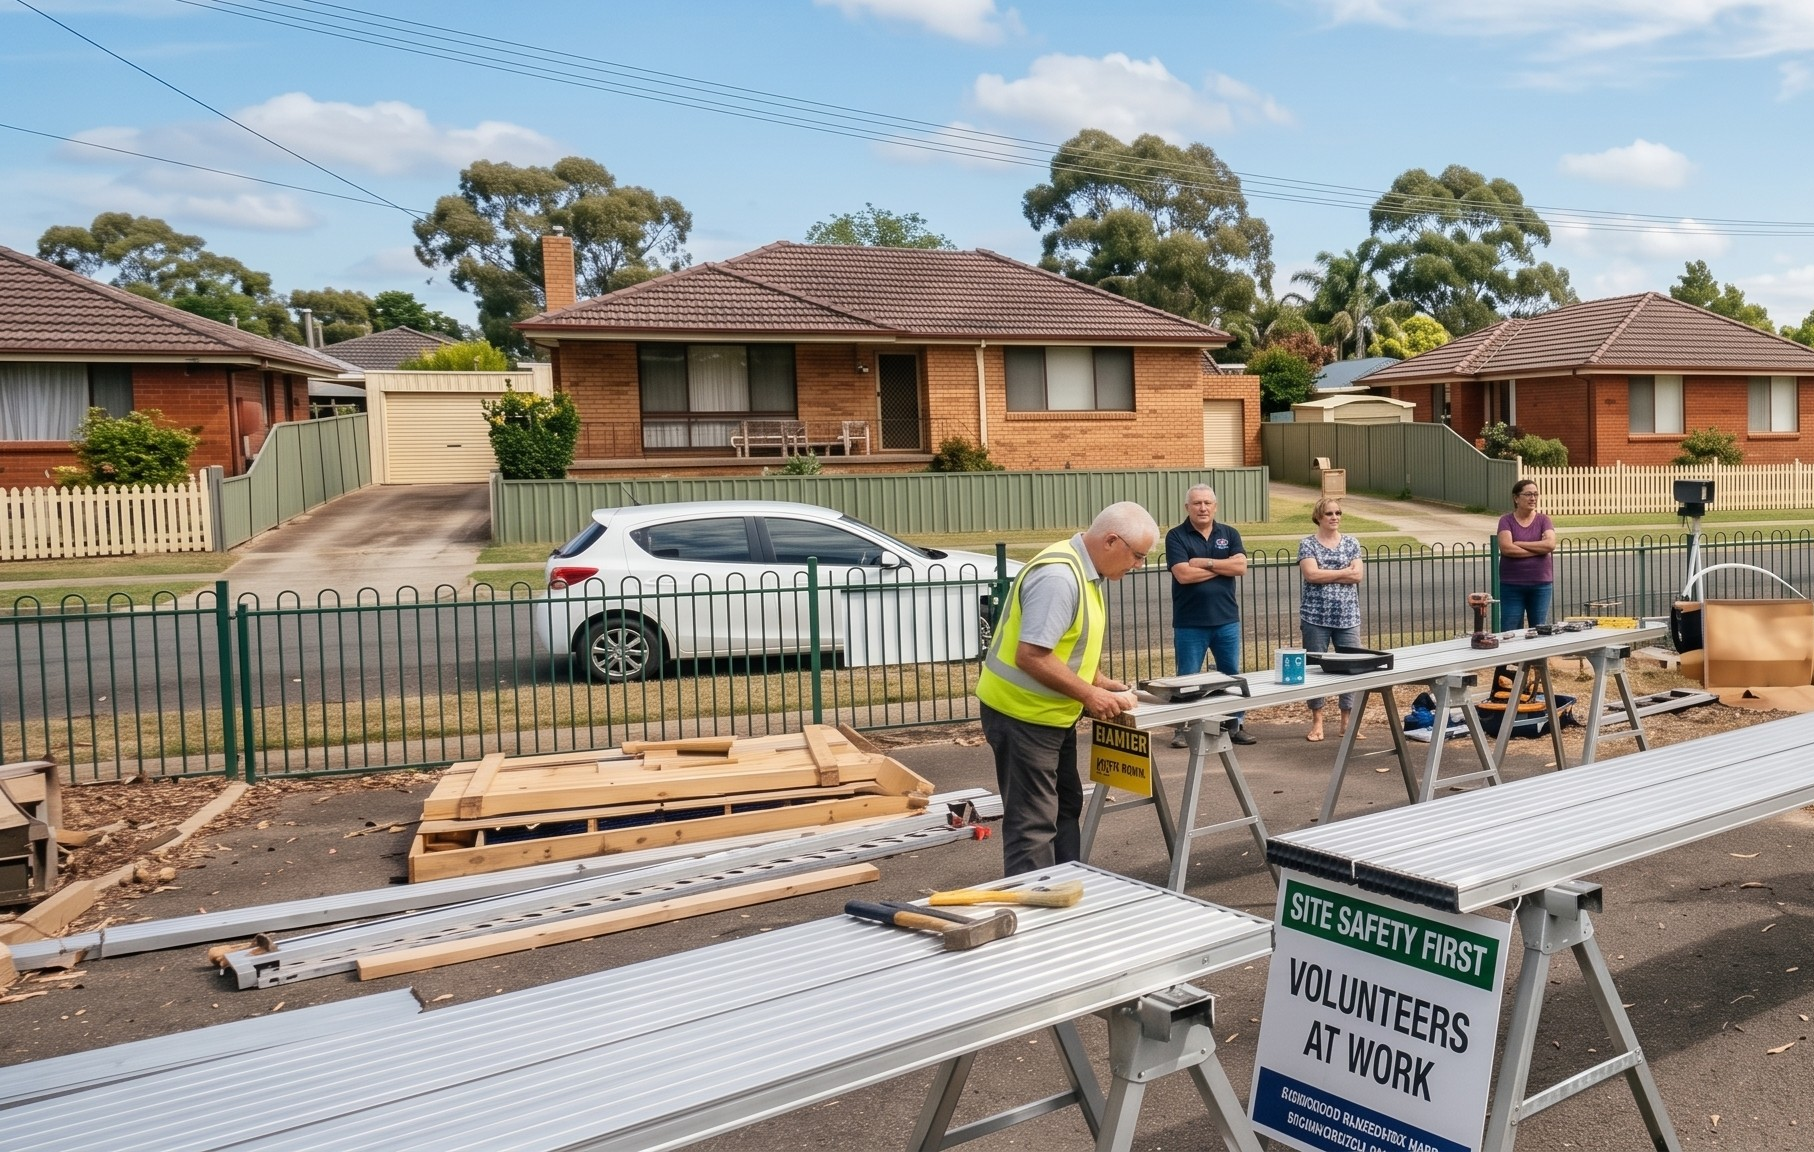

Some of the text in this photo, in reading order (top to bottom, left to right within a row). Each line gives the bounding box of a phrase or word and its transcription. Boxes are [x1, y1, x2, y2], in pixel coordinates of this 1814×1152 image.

[1290, 891, 1488, 976] SITE SAFETY FIRST
[1289, 957, 1471, 1053] VOLUNTEERS
[1302, 1019, 1436, 1102] AT WORK
